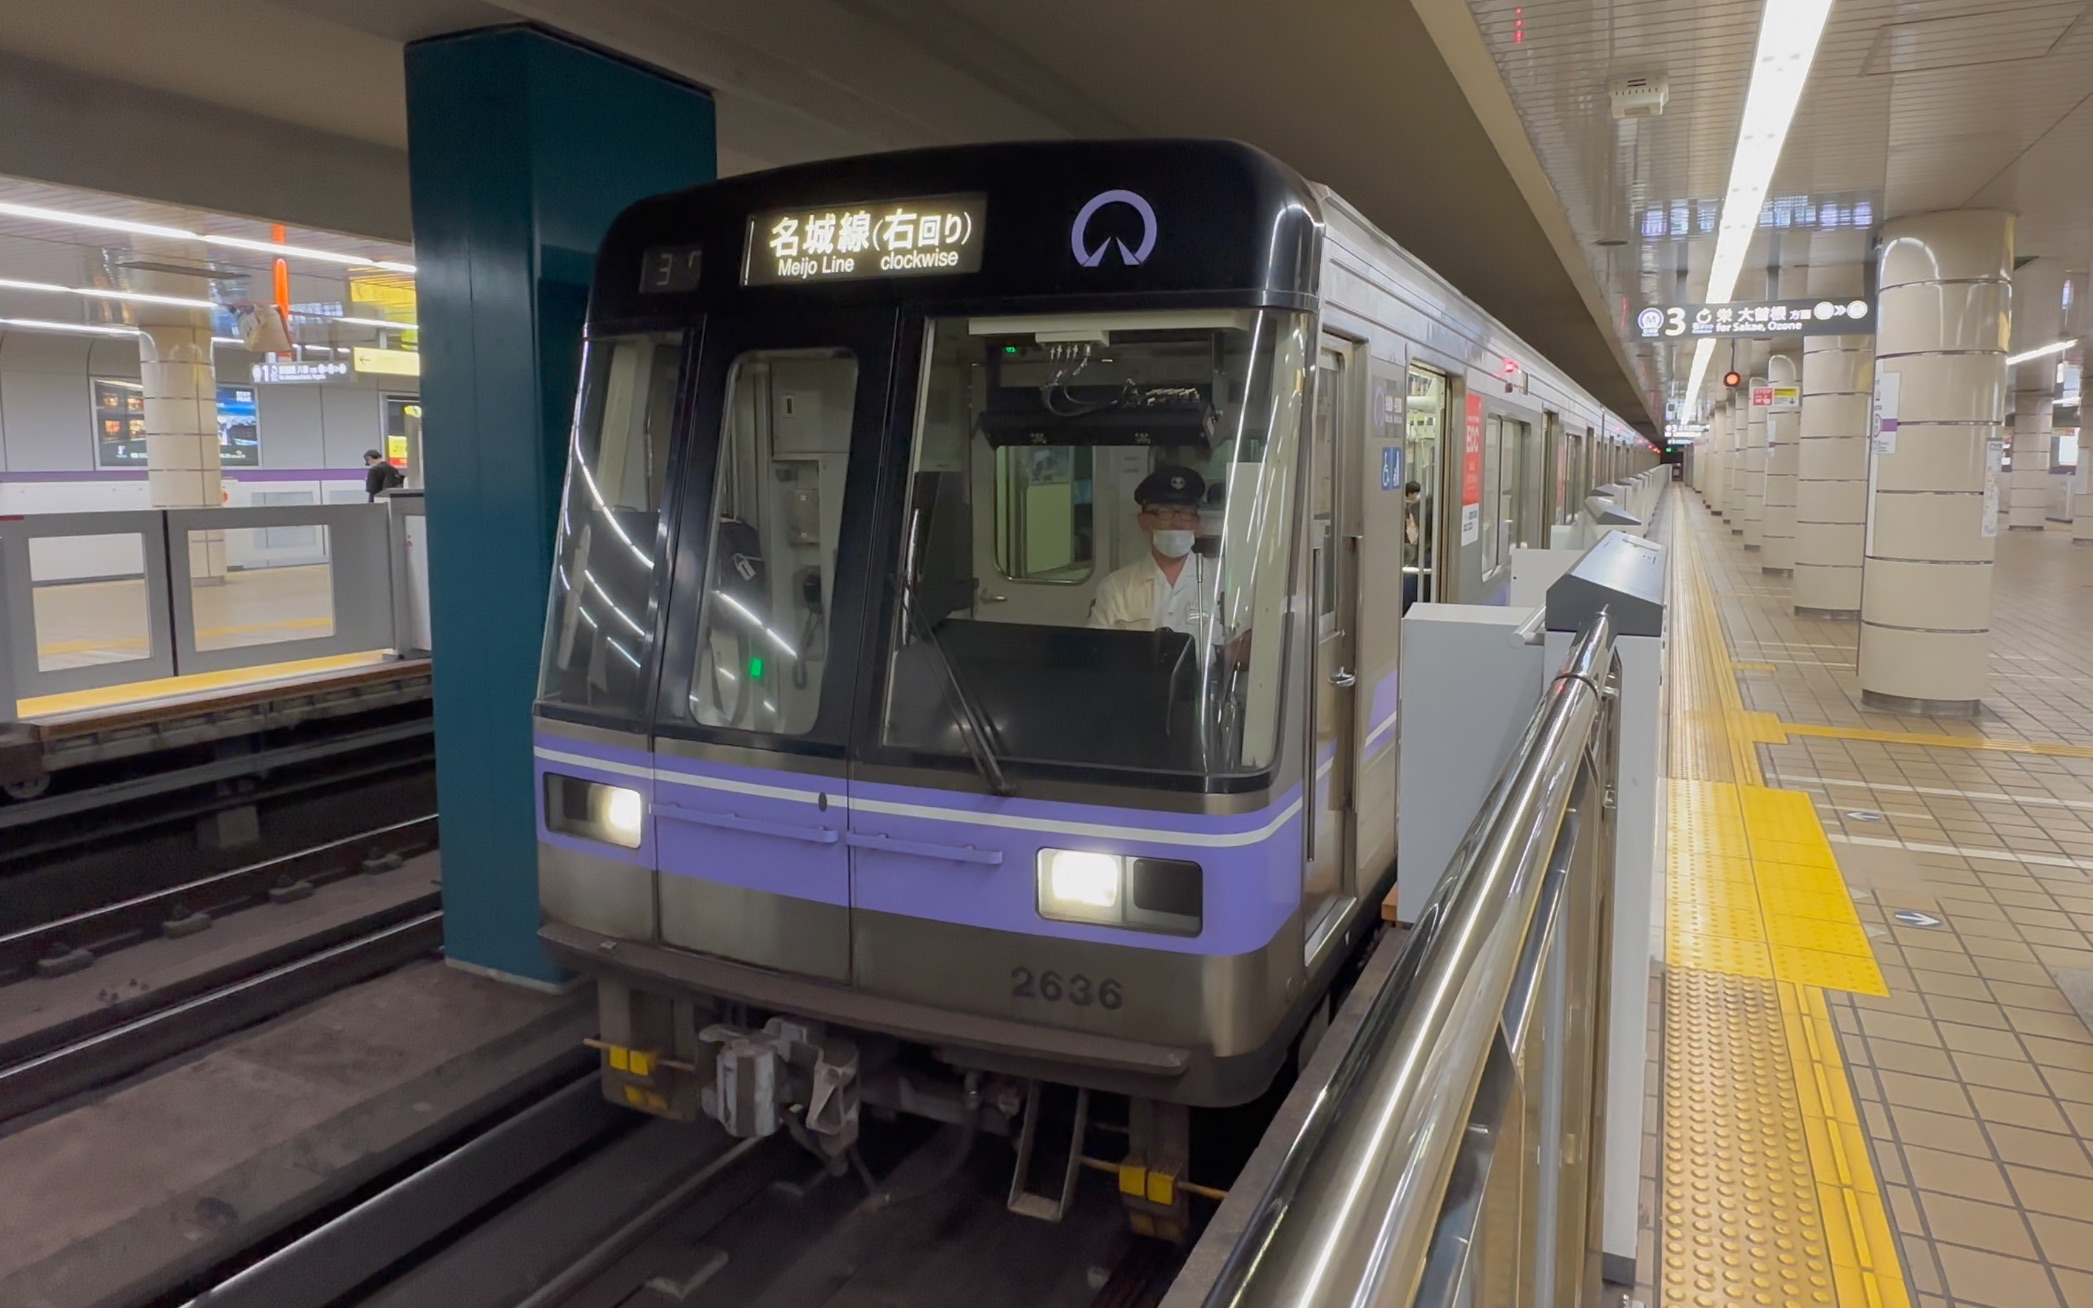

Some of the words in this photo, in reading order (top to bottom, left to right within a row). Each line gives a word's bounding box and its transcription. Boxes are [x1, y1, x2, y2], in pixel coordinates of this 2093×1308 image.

[769, 207, 972, 257] 名城線(右回り)
[778, 258, 817, 279] Meijo
[822, 256, 855, 274] Line
[880, 248, 959, 271] clockwise
[1665, 307, 1687, 336] 3
[1715, 322, 1732, 333] for
[1767, 321, 1803, 331] Ozone
[1011, 966, 1123, 1010] 2636
